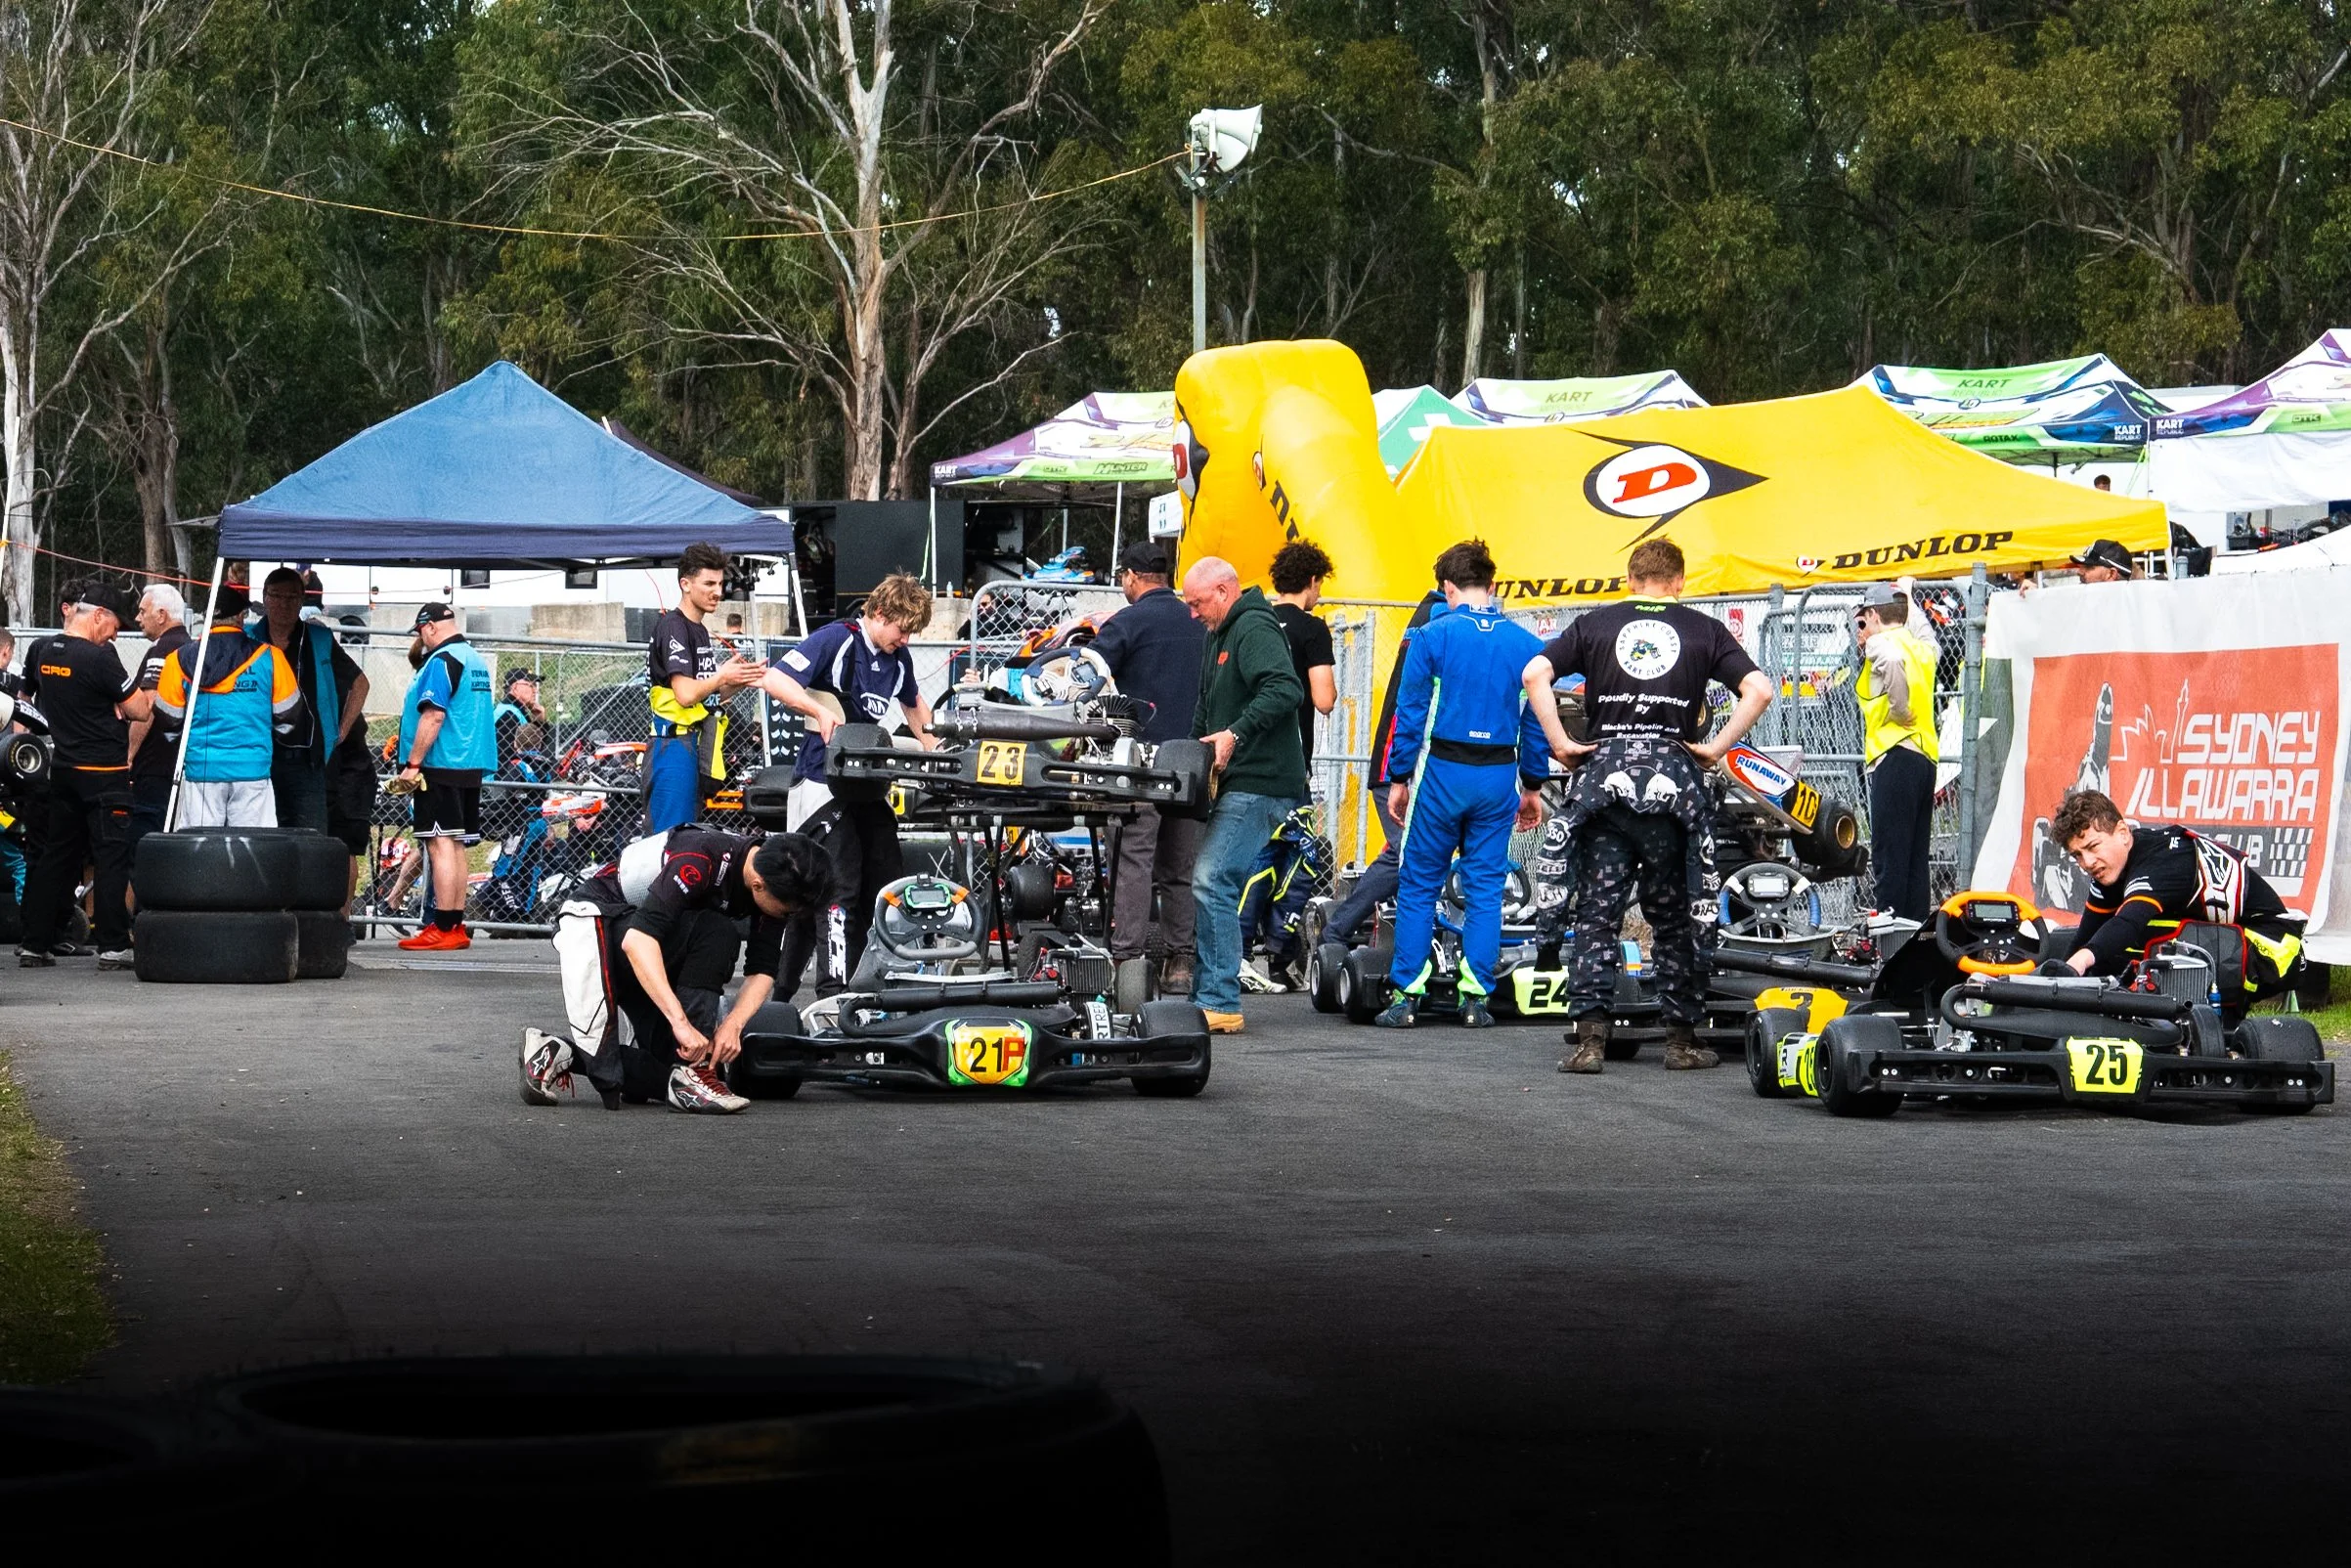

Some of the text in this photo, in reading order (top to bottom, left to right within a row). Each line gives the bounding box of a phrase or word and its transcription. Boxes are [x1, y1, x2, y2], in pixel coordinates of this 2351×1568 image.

[1546, 391, 1592, 403] KART
[1958, 379, 2013, 388] KART
[2113, 424, 2142, 434] KART
[2155, 419, 2185, 428] KART
[934, 465, 958, 474] KART
[1613, 461, 1698, 504] D
[1832, 531, 2013, 570] DUNLOP
[1494, 575, 1629, 599] UNLOP
[1634, 704, 1650, 715] By
[1637, 693, 1690, 708] Supported
[2177, 711, 2321, 764] SYDNEY
[982, 745, 1019, 780] 23
[1737, 756, 1787, 786] RUNAWAY
[2125, 767, 2321, 822] ILLAWARRA
[1528, 978, 1570, 1008] 24
[2085, 1044, 2128, 1086] 25
